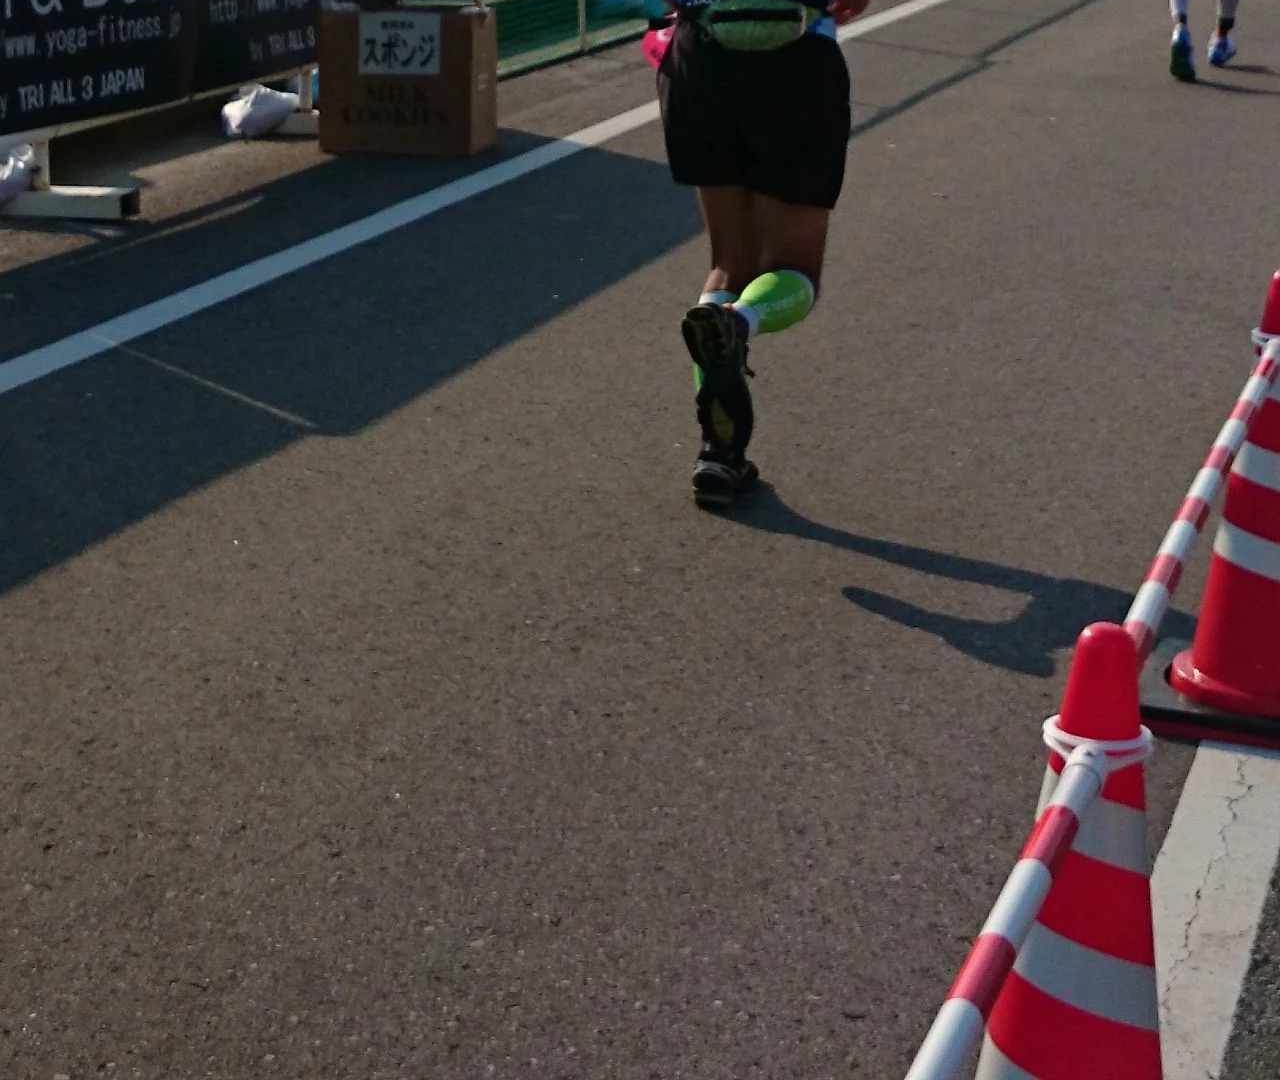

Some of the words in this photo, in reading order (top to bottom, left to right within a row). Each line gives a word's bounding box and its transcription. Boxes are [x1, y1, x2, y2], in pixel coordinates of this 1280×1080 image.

[363, 32, 437, 68] スポンジ
[18, 83, 44, 112] TRI
[50, 78, 76, 106] ALL
[81, 75, 93, 101] 3
[100, 66, 145, 98] JAPAN
